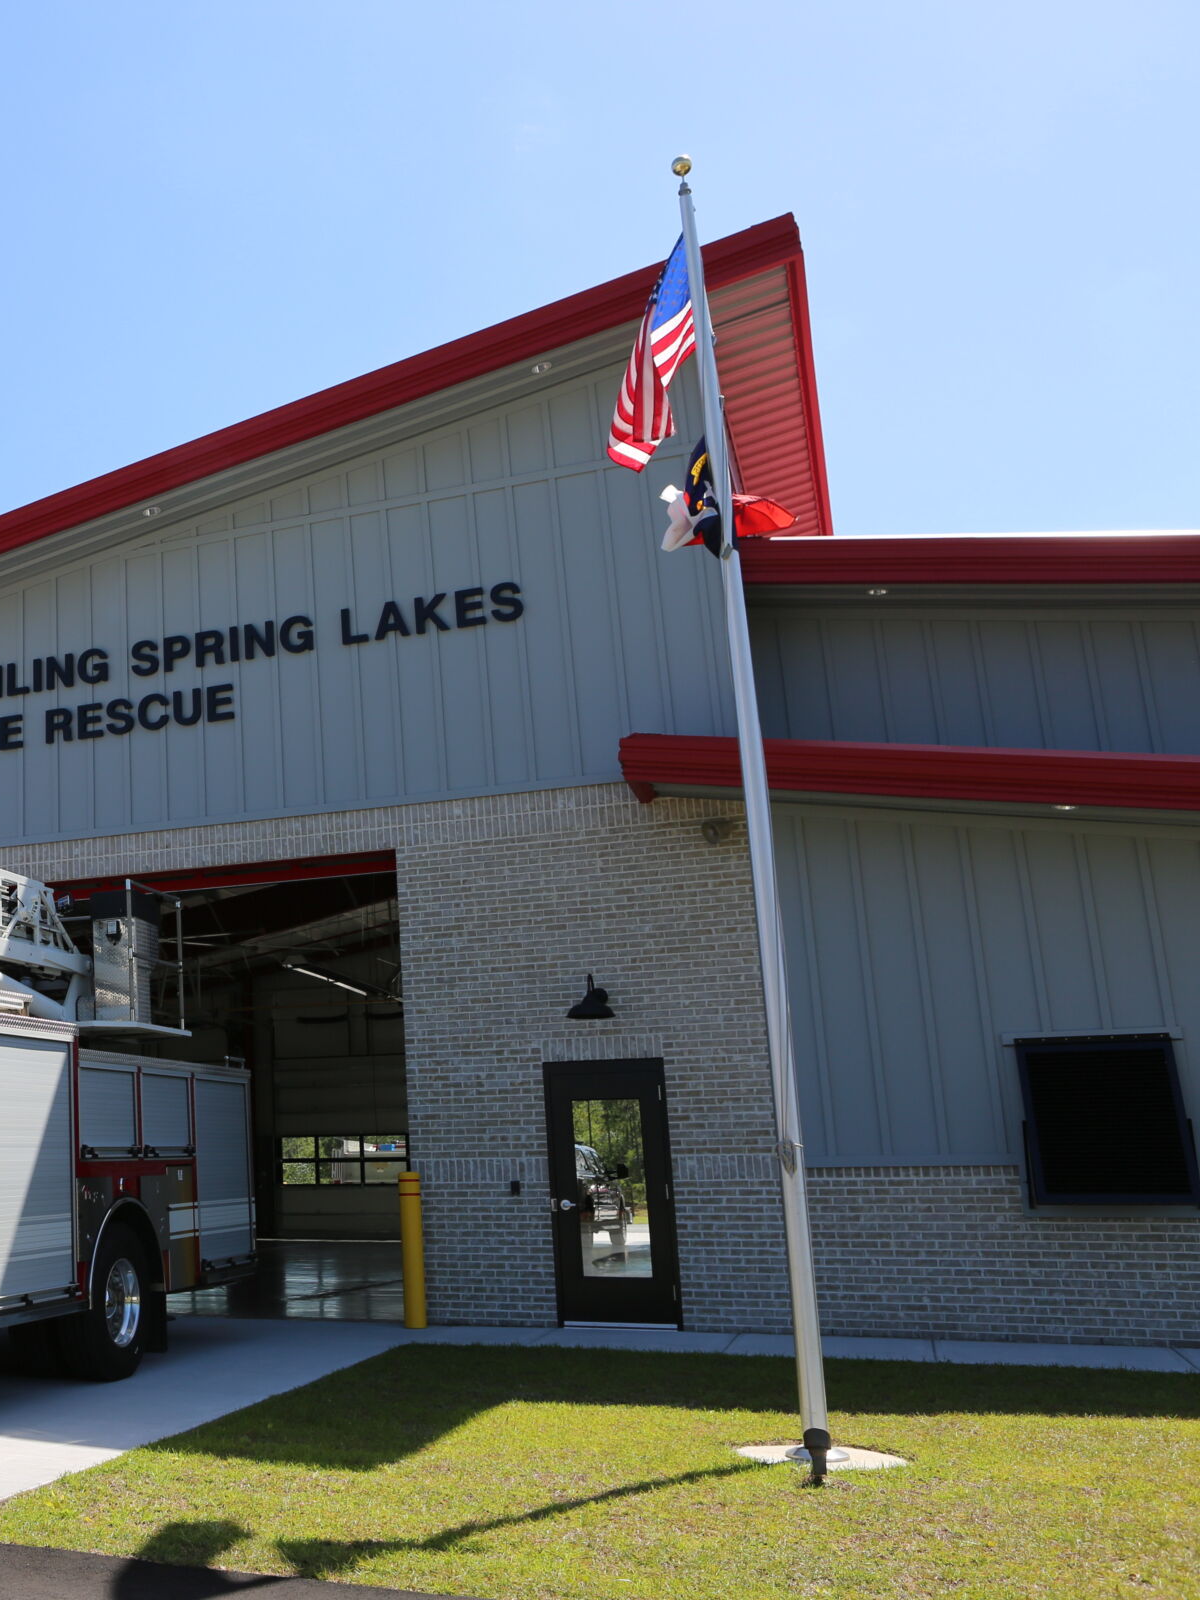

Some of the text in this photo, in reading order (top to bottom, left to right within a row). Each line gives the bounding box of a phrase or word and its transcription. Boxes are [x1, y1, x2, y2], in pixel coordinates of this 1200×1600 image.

[131, 615, 314, 677] SPRING
[340, 582, 524, 645] LAKES
[45, 683, 235, 746] RESCUE
